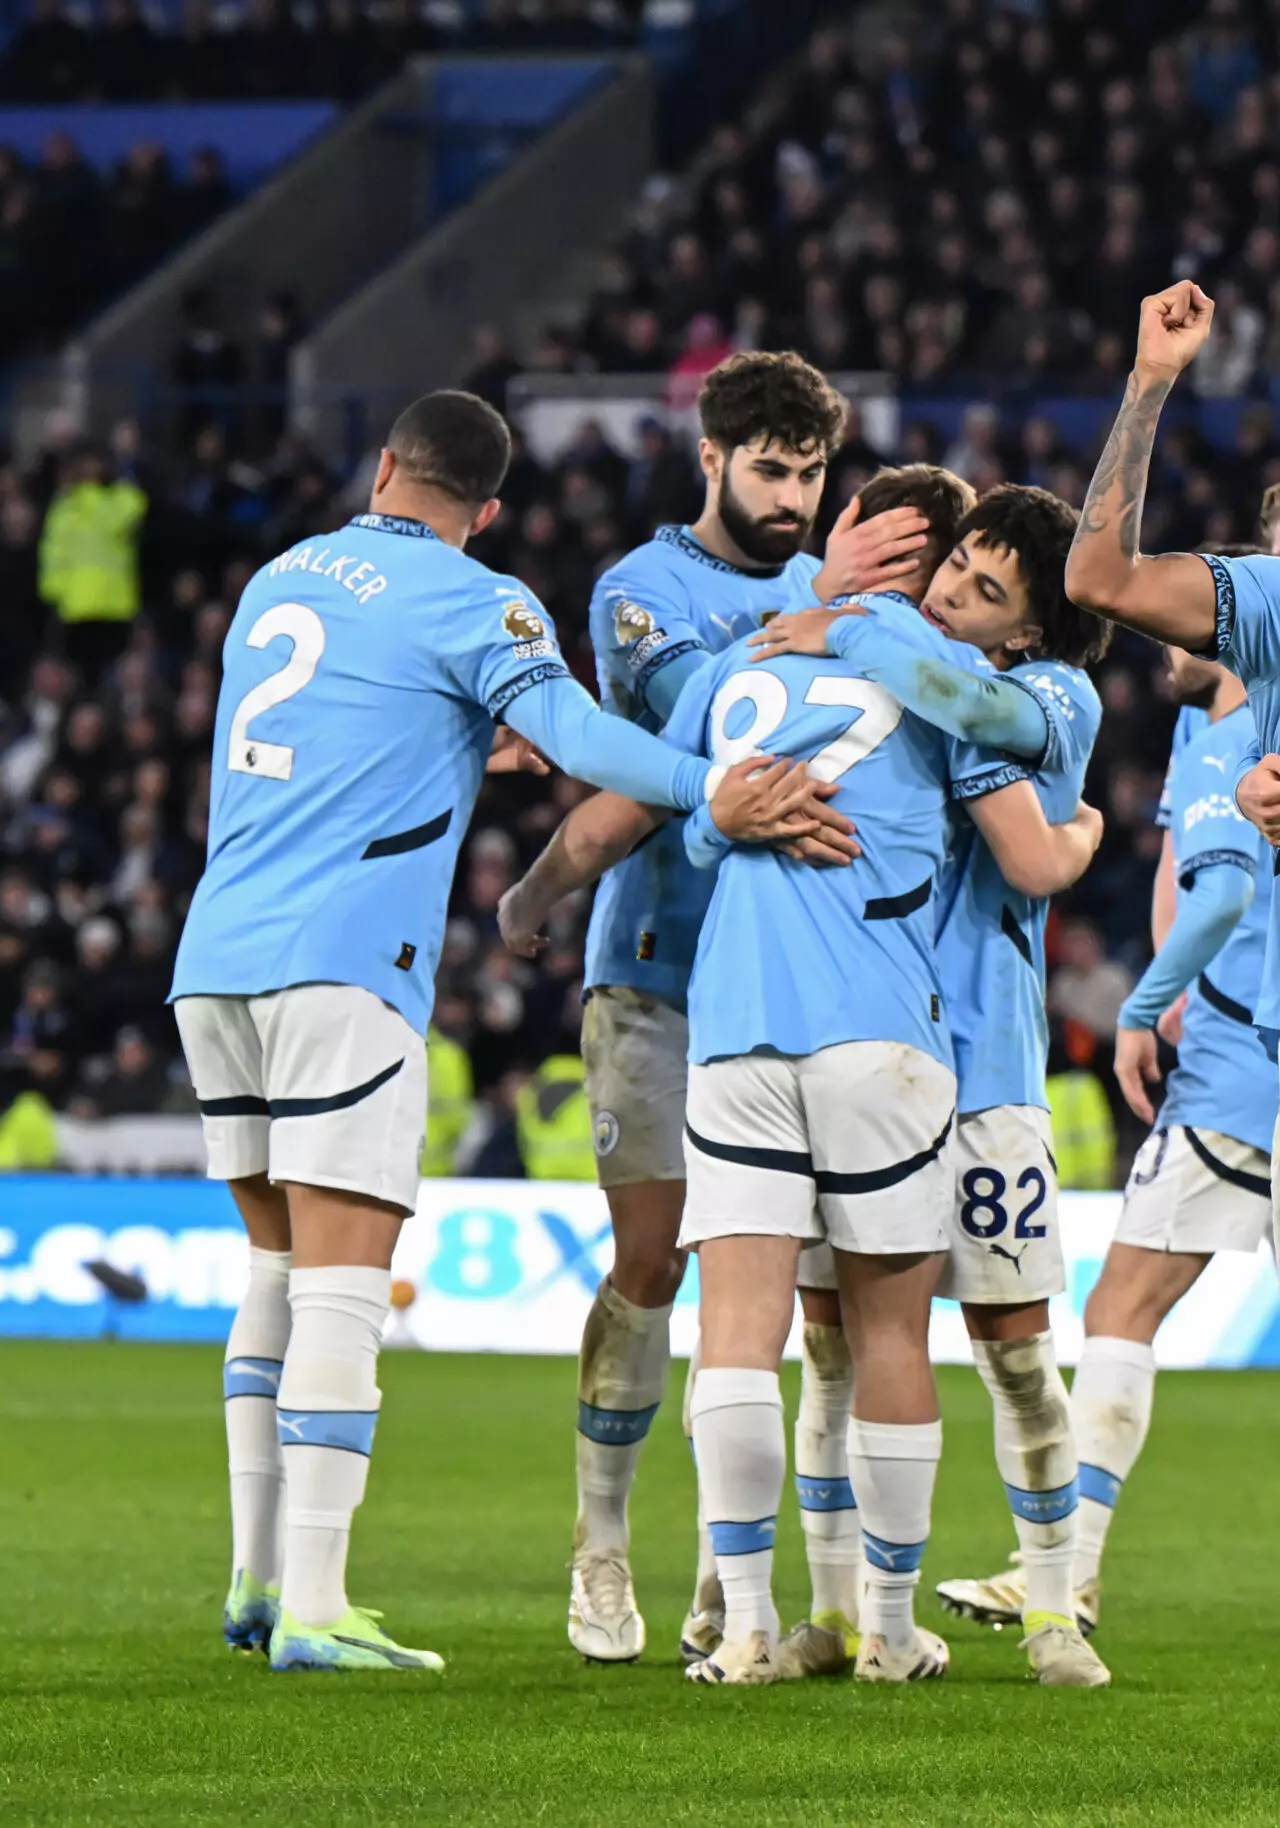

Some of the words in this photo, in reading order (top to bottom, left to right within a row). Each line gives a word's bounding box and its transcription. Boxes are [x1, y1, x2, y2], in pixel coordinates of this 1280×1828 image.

[269, 547, 388, 604] WALKER
[227, 602, 326, 782] 2
[960, 1166, 1048, 1239] 82
[0, 1223, 250, 1308] .com
